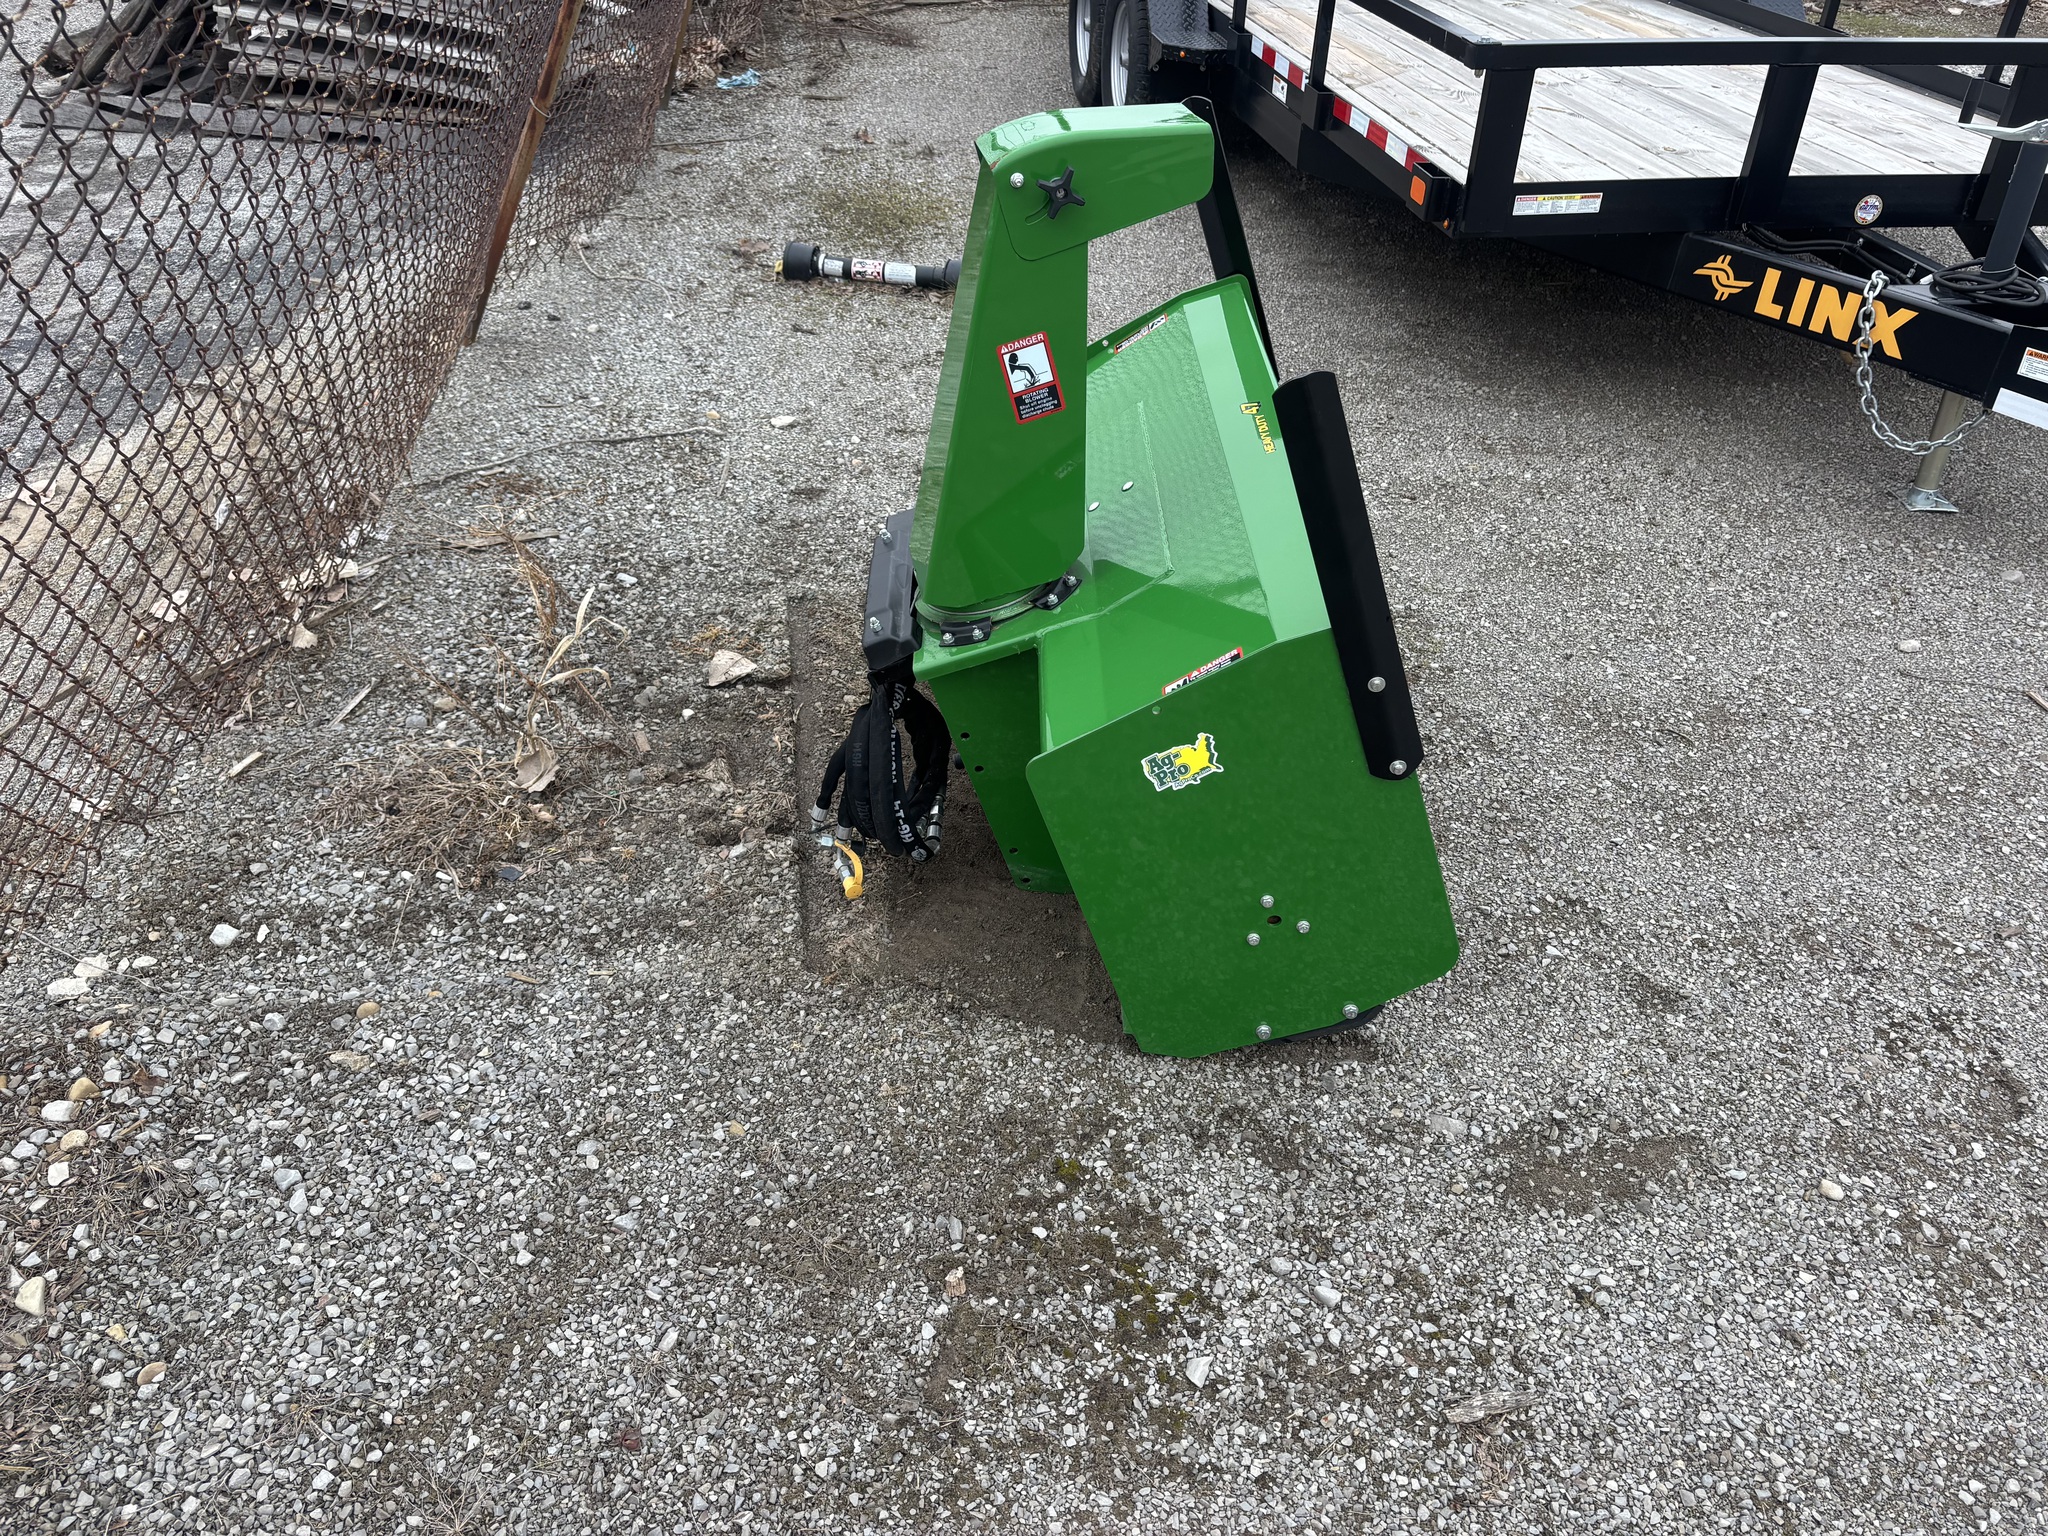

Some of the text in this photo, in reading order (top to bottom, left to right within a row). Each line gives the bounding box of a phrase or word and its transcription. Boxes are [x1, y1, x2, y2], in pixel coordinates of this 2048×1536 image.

[1754, 267, 1919, 360] LINX
[1007, 333, 1044, 351] DANGER
[1022, 387, 1049, 400] ROTATING
[1025, 392, 1048, 404] BLOWER
[1240, 402, 1276, 454] HEAVY DUTY 47
[1200, 649, 1238, 672] DANGER
[1147, 752, 1180, 775] Ag-
[1154, 764, 1189, 787] Pro
